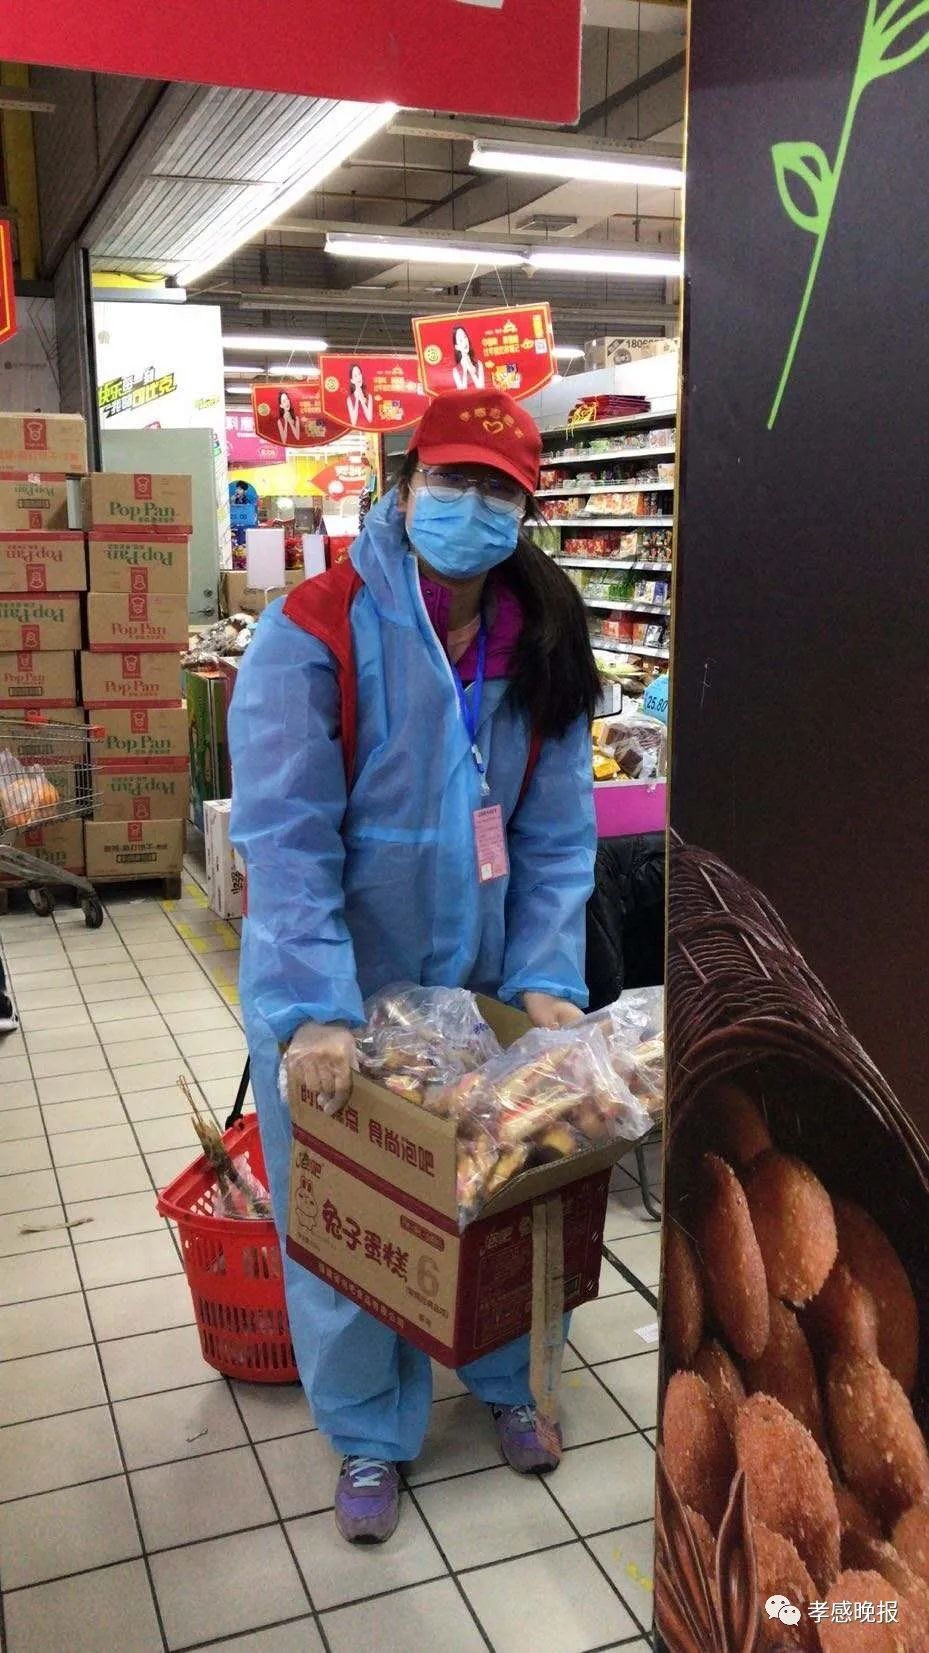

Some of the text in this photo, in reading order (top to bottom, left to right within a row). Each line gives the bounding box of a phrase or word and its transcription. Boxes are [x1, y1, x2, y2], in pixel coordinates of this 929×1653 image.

[109, 501, 175, 522] Pop Pan
[6, 546, 63, 562] Pop Pan
[107, 547, 173, 566] Pop Pan
[33, 604, 65, 622] Pop
[111, 623, 167, 639] Pop Pan
[4, 672, 45, 684] Pop Pan
[105, 681, 160, 696] Pop Pan
[107, 735, 171, 753] Pop Pan
[111, 779, 175, 796] Pop Pan
[368, 1118, 435, 1178] 食尚泡吧
[322, 1199, 409, 1283] 兔子蛋糕
[416, 1254, 440, 1297] 6
